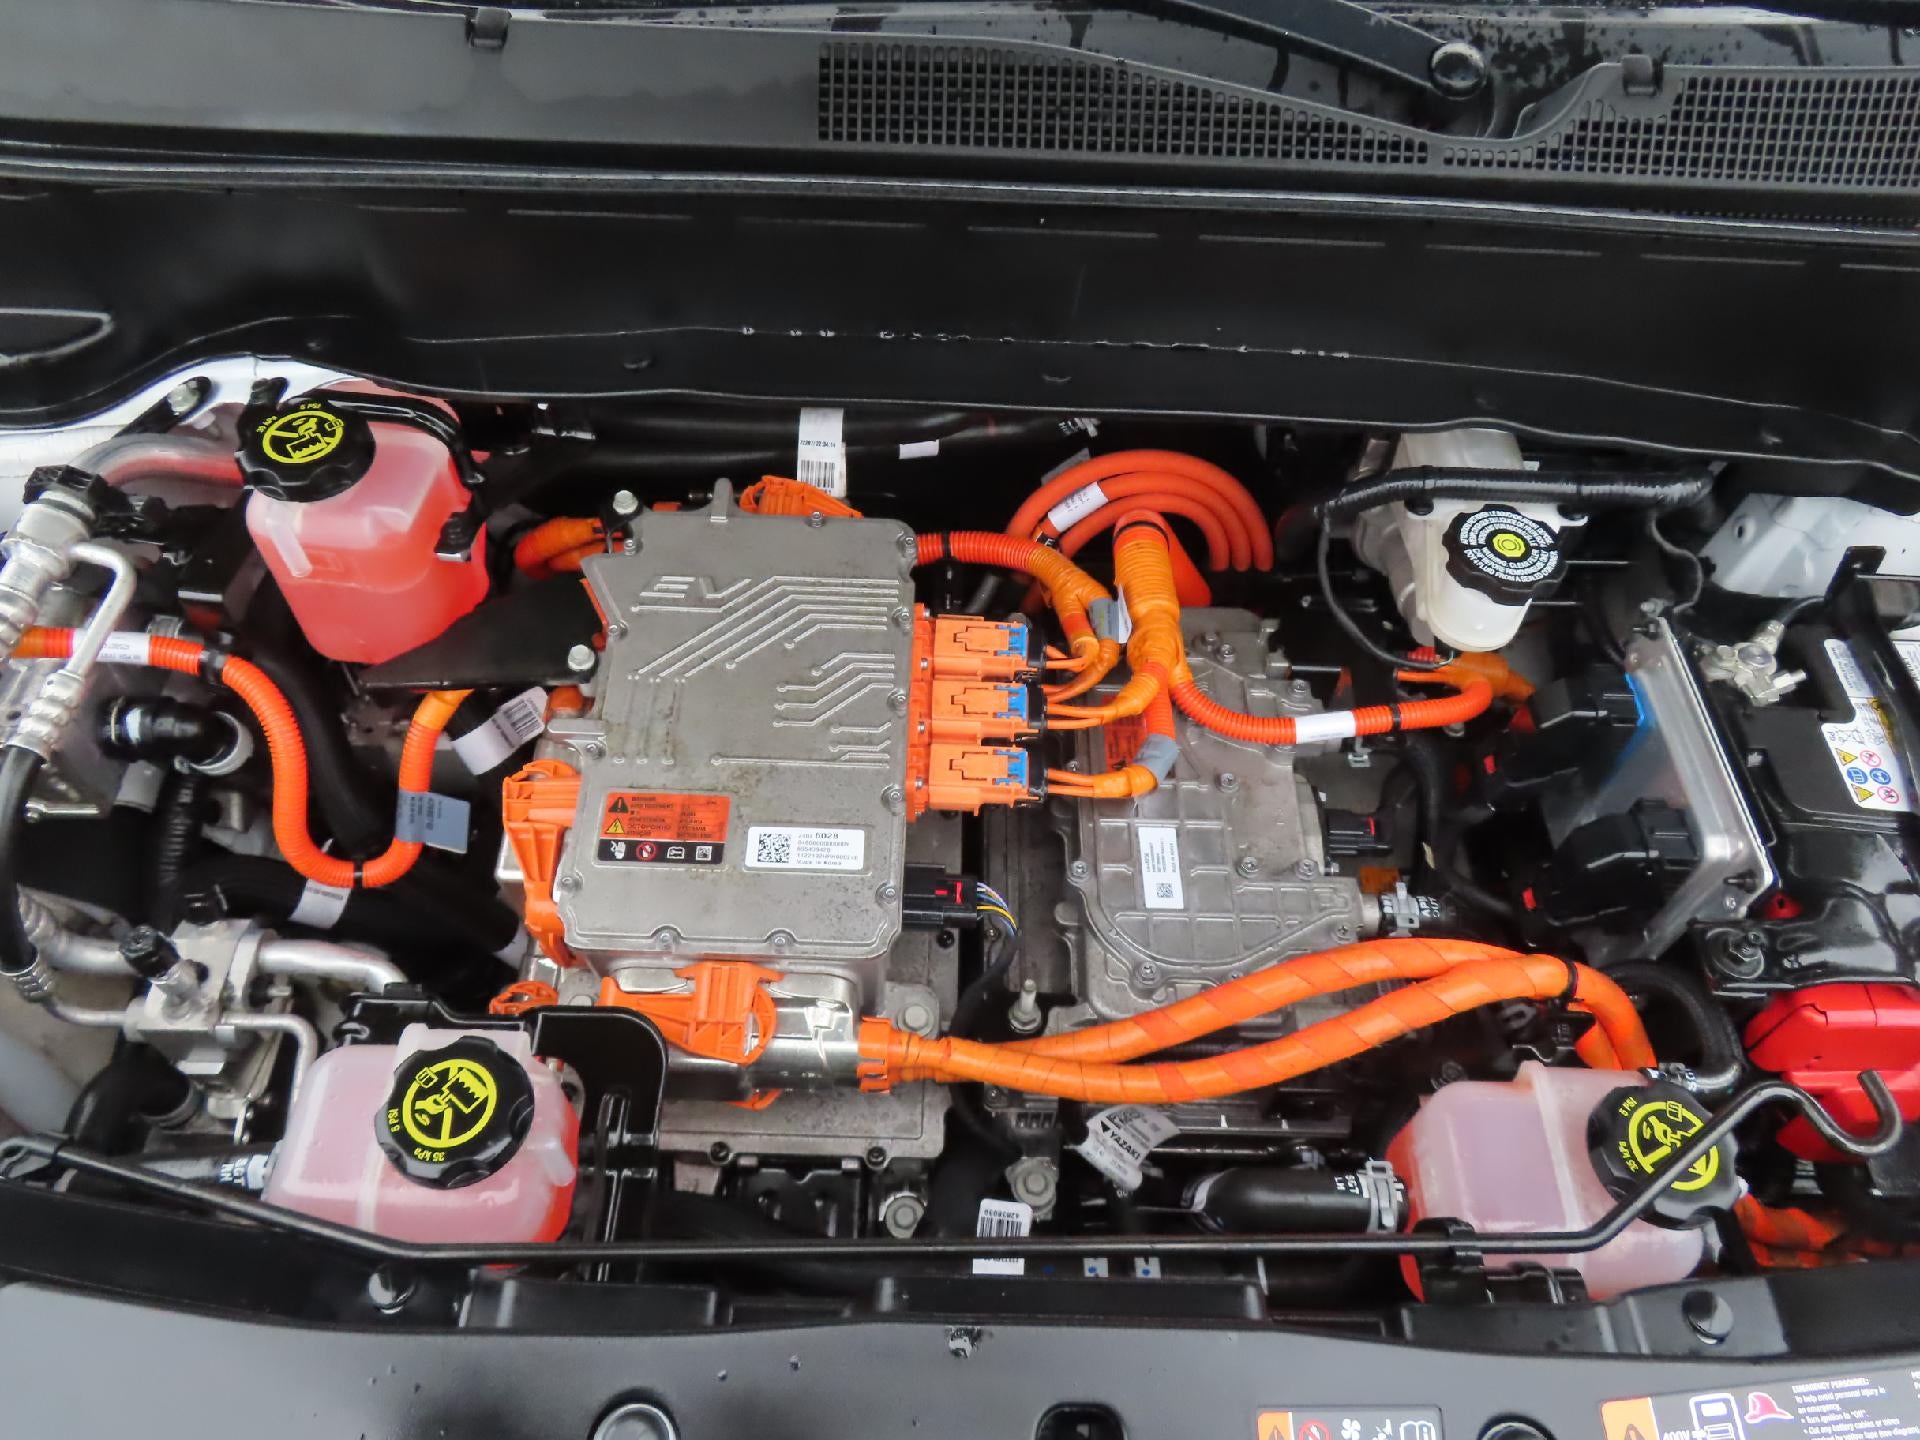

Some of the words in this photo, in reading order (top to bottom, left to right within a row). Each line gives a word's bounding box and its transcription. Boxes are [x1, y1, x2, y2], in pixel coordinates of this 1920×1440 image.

[1622, 1096, 1637, 1111] PSI
[388, 1108, 400, 1124] PSI
[1110, 1130, 1140, 1160] YAZAKI
[414, 1148, 432, 1162] kPa
